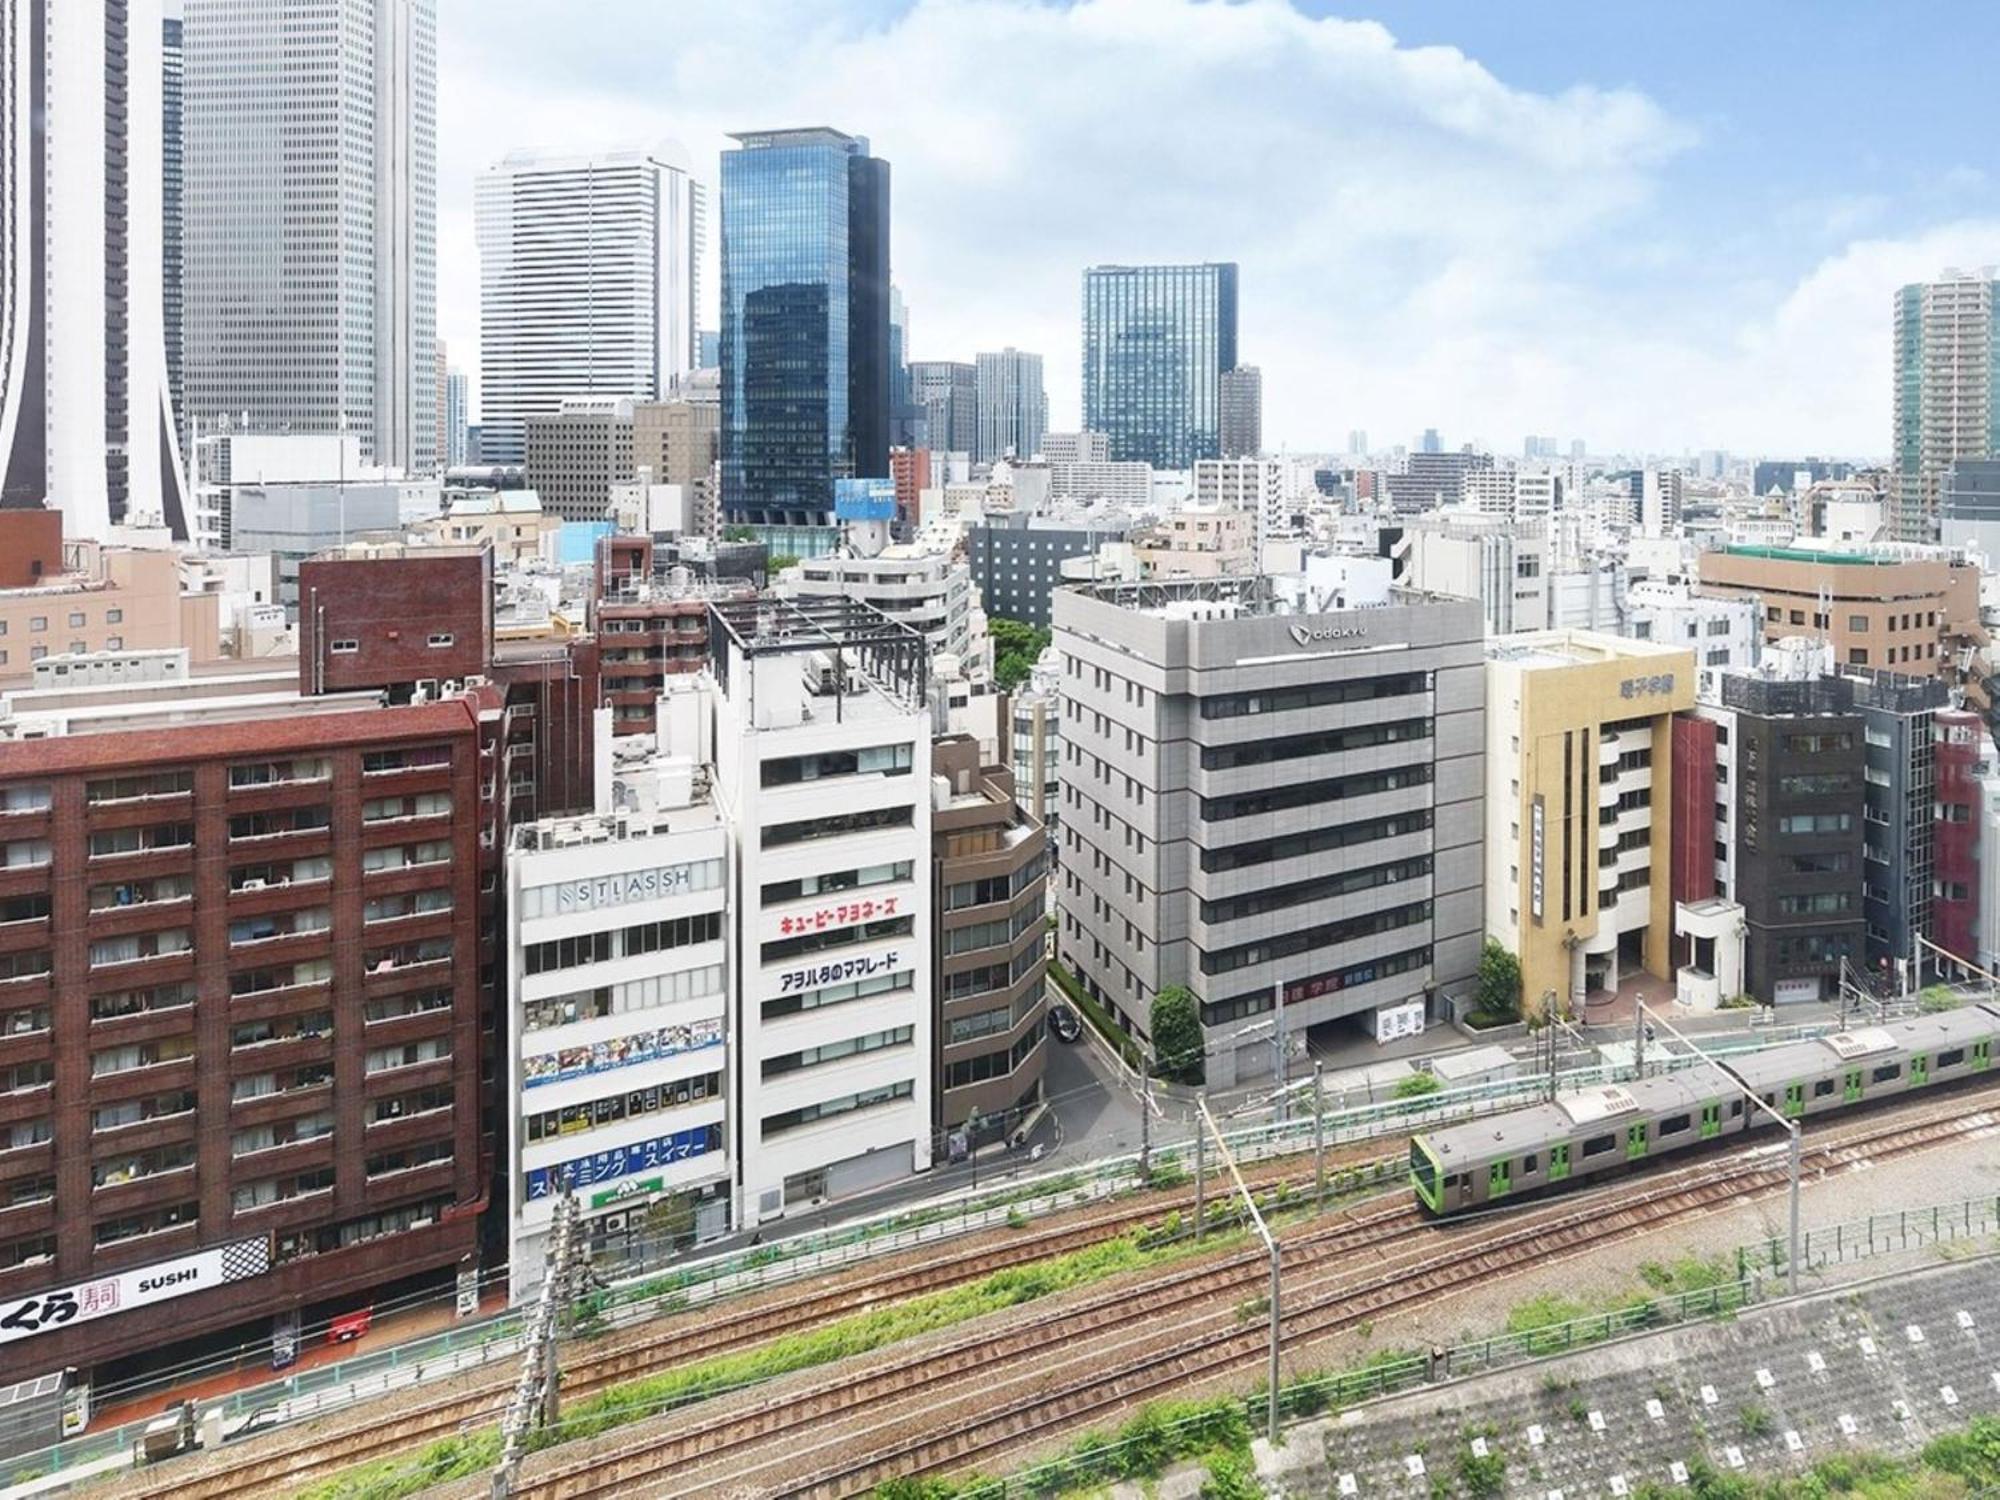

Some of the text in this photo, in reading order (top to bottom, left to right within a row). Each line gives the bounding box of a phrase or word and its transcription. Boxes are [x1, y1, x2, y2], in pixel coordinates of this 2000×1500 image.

[578, 869, 690, 902] STLASSH
[645, 1143, 705, 1167] スイマー
[138, 1268, 199, 1293] SUSHI
